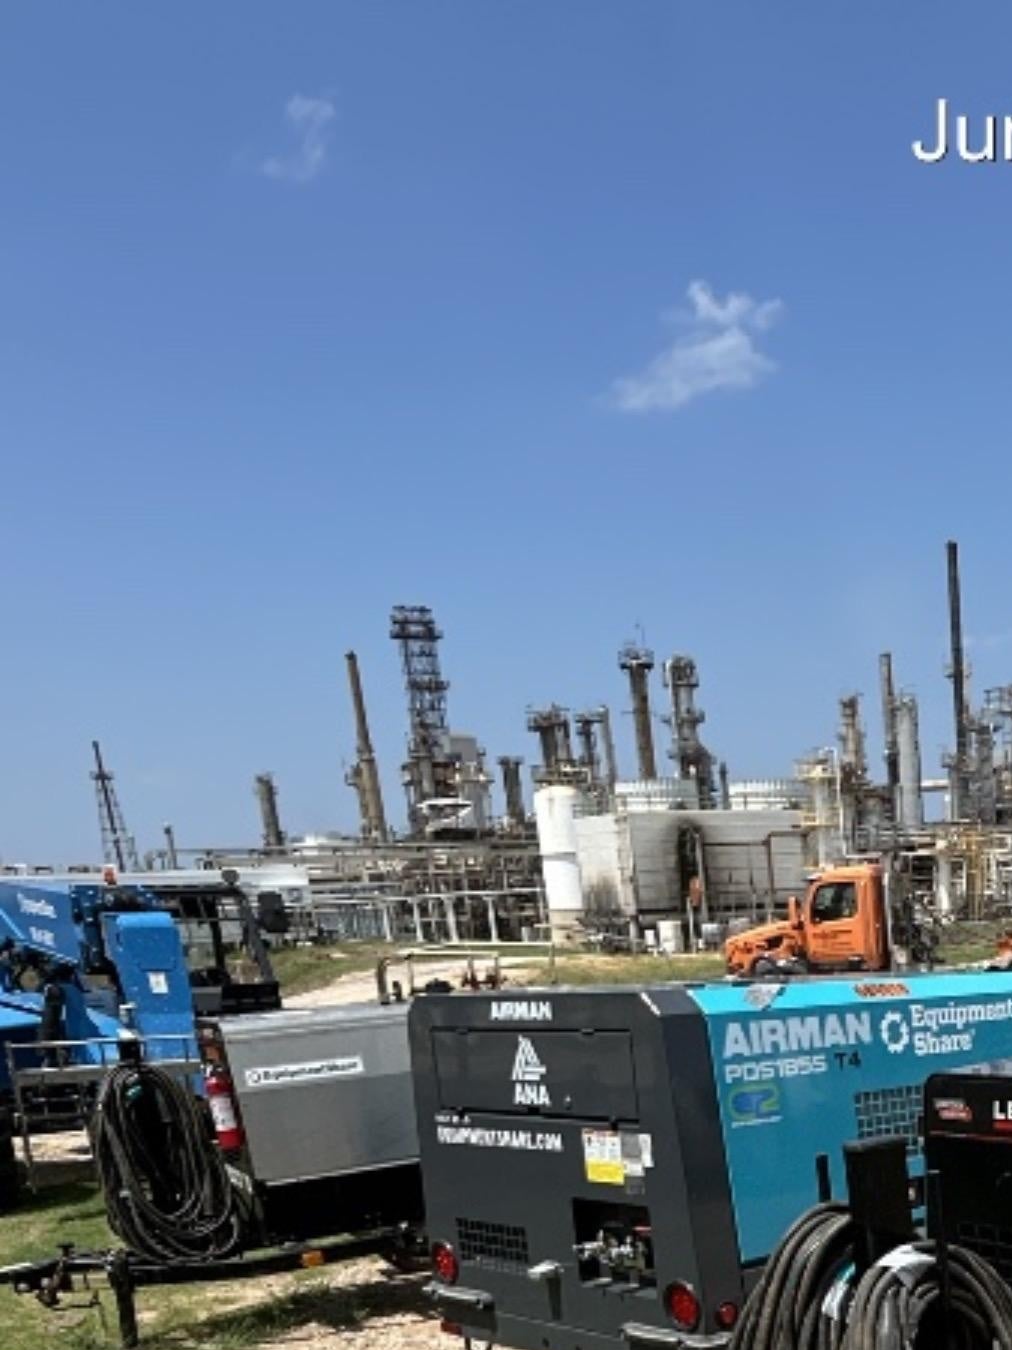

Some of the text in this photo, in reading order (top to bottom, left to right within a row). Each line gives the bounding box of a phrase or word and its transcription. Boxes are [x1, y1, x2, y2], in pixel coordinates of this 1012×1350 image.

[490, 1001, 553, 1021] AIRMAN
[722, 1010, 872, 1059] AIRMAN
[914, 1031, 973, 1057] Share
[834, 1051, 862, 1071] T4
[514, 1083, 551, 1106] ANA
